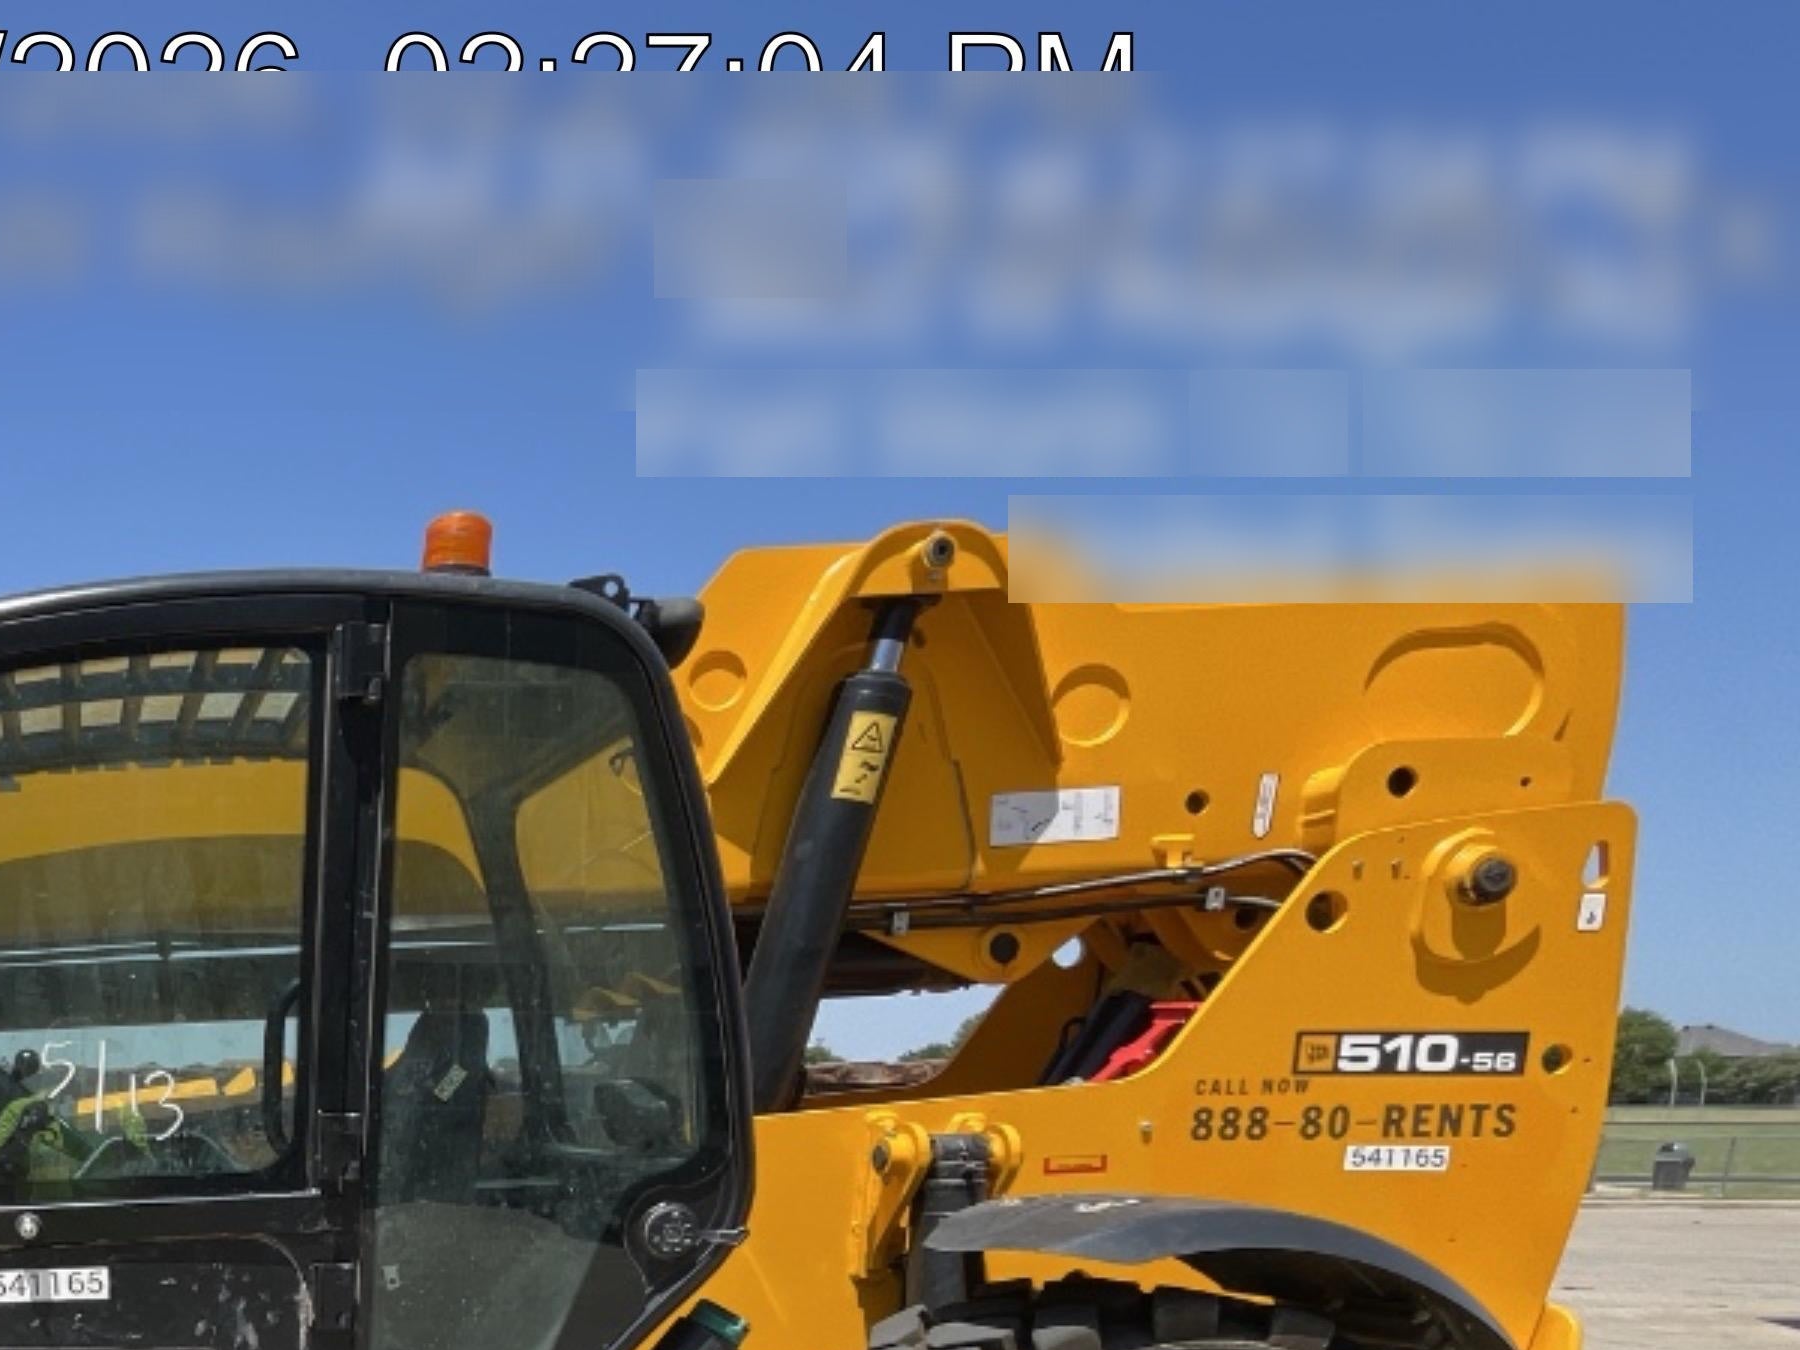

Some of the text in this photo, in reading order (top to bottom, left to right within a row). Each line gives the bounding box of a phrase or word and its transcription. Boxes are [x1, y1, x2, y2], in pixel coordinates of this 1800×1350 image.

[1337, 1033, 1517, 1073] 510-56
[1195, 1078, 1312, 1096] CALL NOW
[1350, 1147, 1446, 1168] 541165
